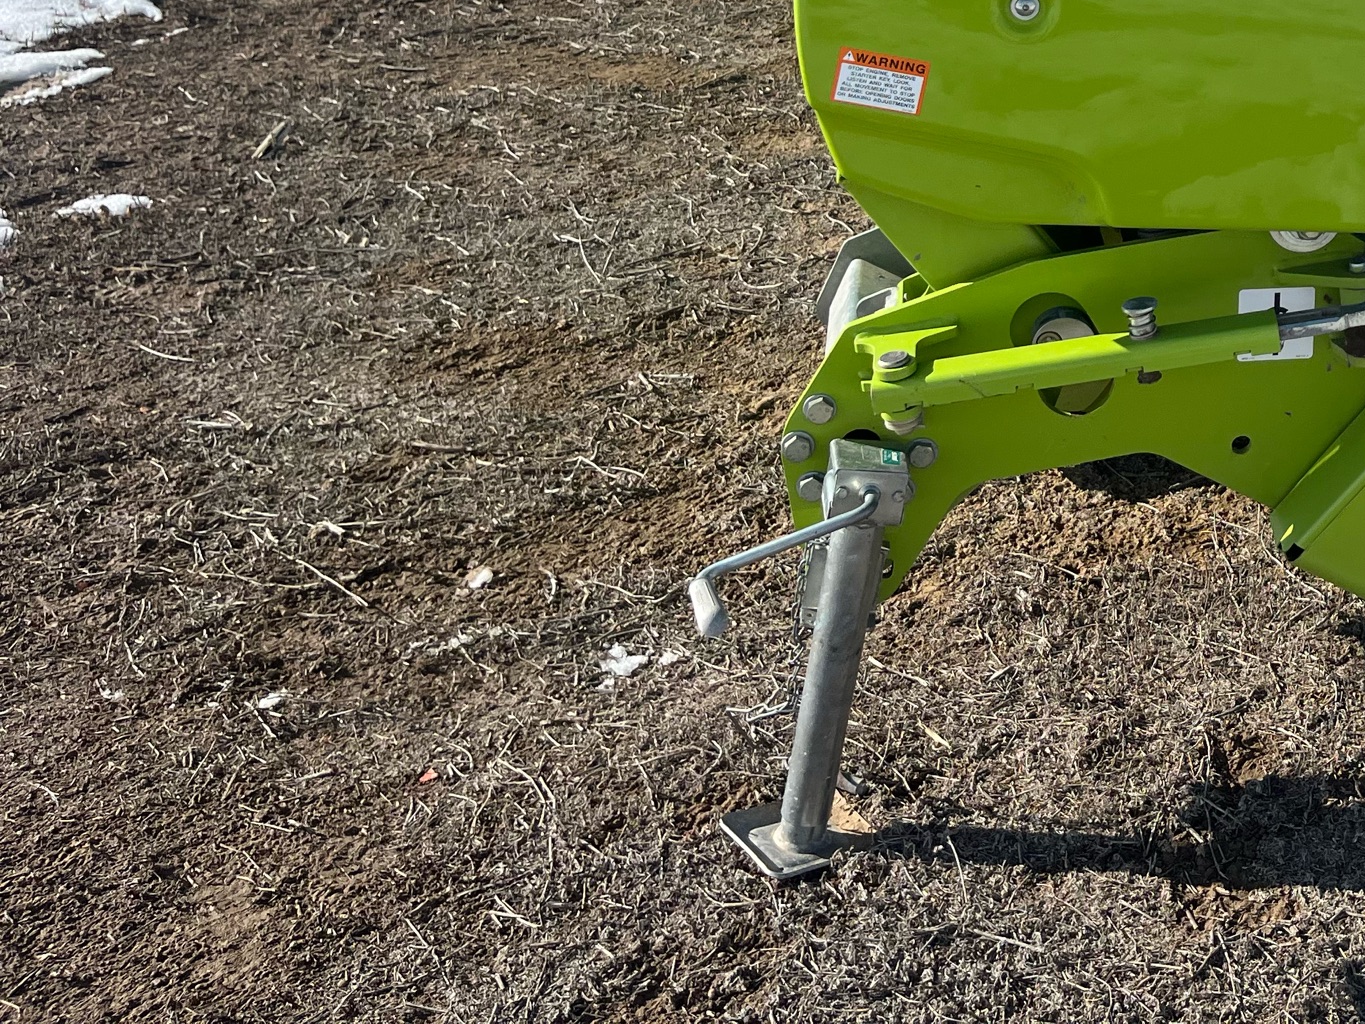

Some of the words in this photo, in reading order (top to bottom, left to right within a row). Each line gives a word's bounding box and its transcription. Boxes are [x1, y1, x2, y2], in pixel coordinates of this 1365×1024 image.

[856, 53, 926, 74] WARNING
[851, 72, 877, 80] STARTER
[892, 73, 916, 81] REMOVE
[855, 84, 887, 93] MOVEMENT
[865, 91, 892, 99] OPENING
[848, 93, 871, 101] MAKING
[873, 98, 915, 109] ADJUSTMENTS
